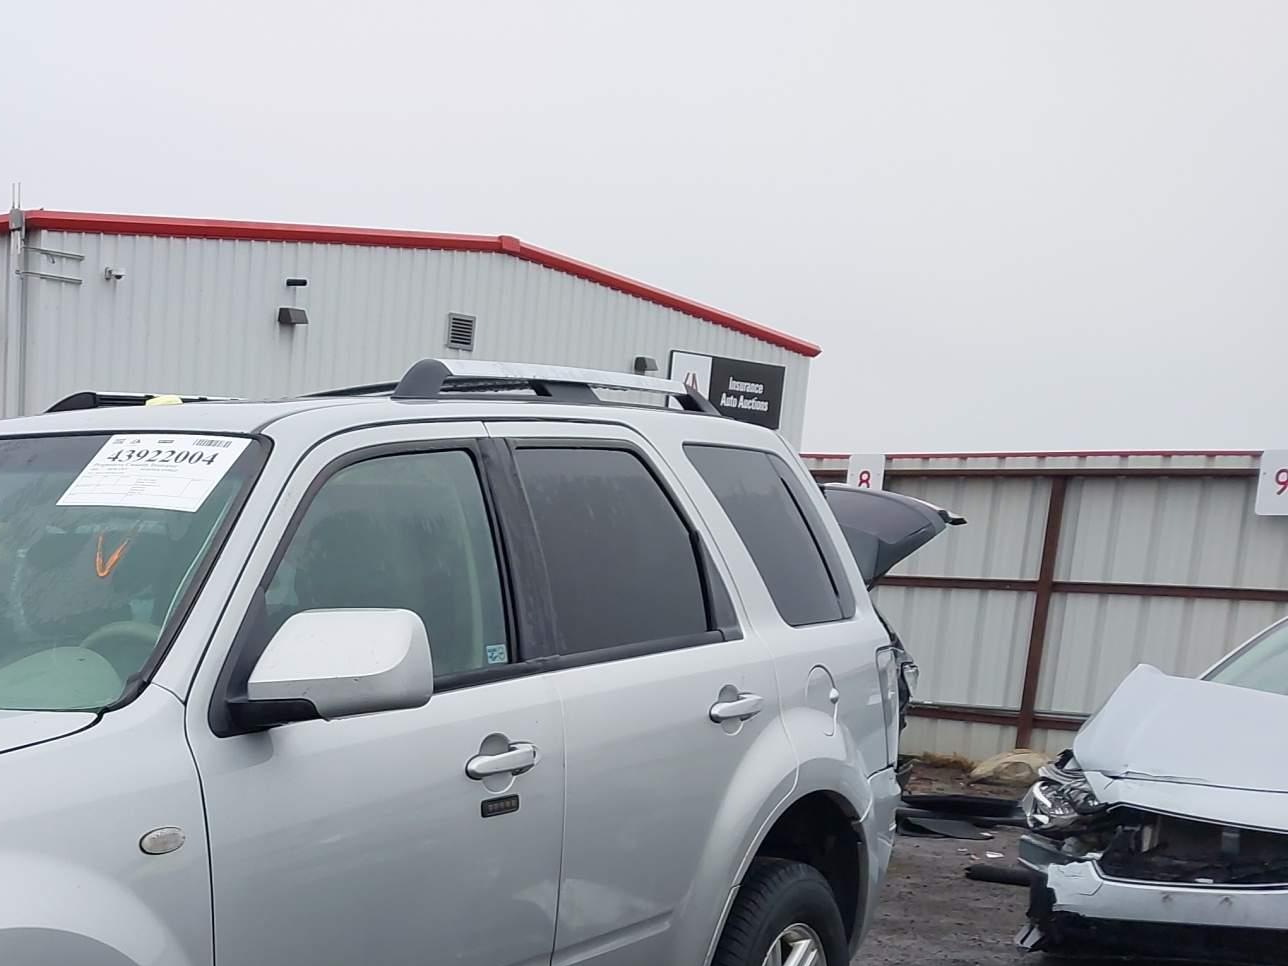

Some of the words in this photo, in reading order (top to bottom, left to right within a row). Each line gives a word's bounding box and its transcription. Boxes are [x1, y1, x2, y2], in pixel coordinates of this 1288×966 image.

[728, 376, 764, 394] Insurance
[720, 392, 738, 408] Auto
[738, 395, 769, 412] Auctions
[107, 449, 219, 466] 43922004
[1275, 468, 1288, 495] 9
